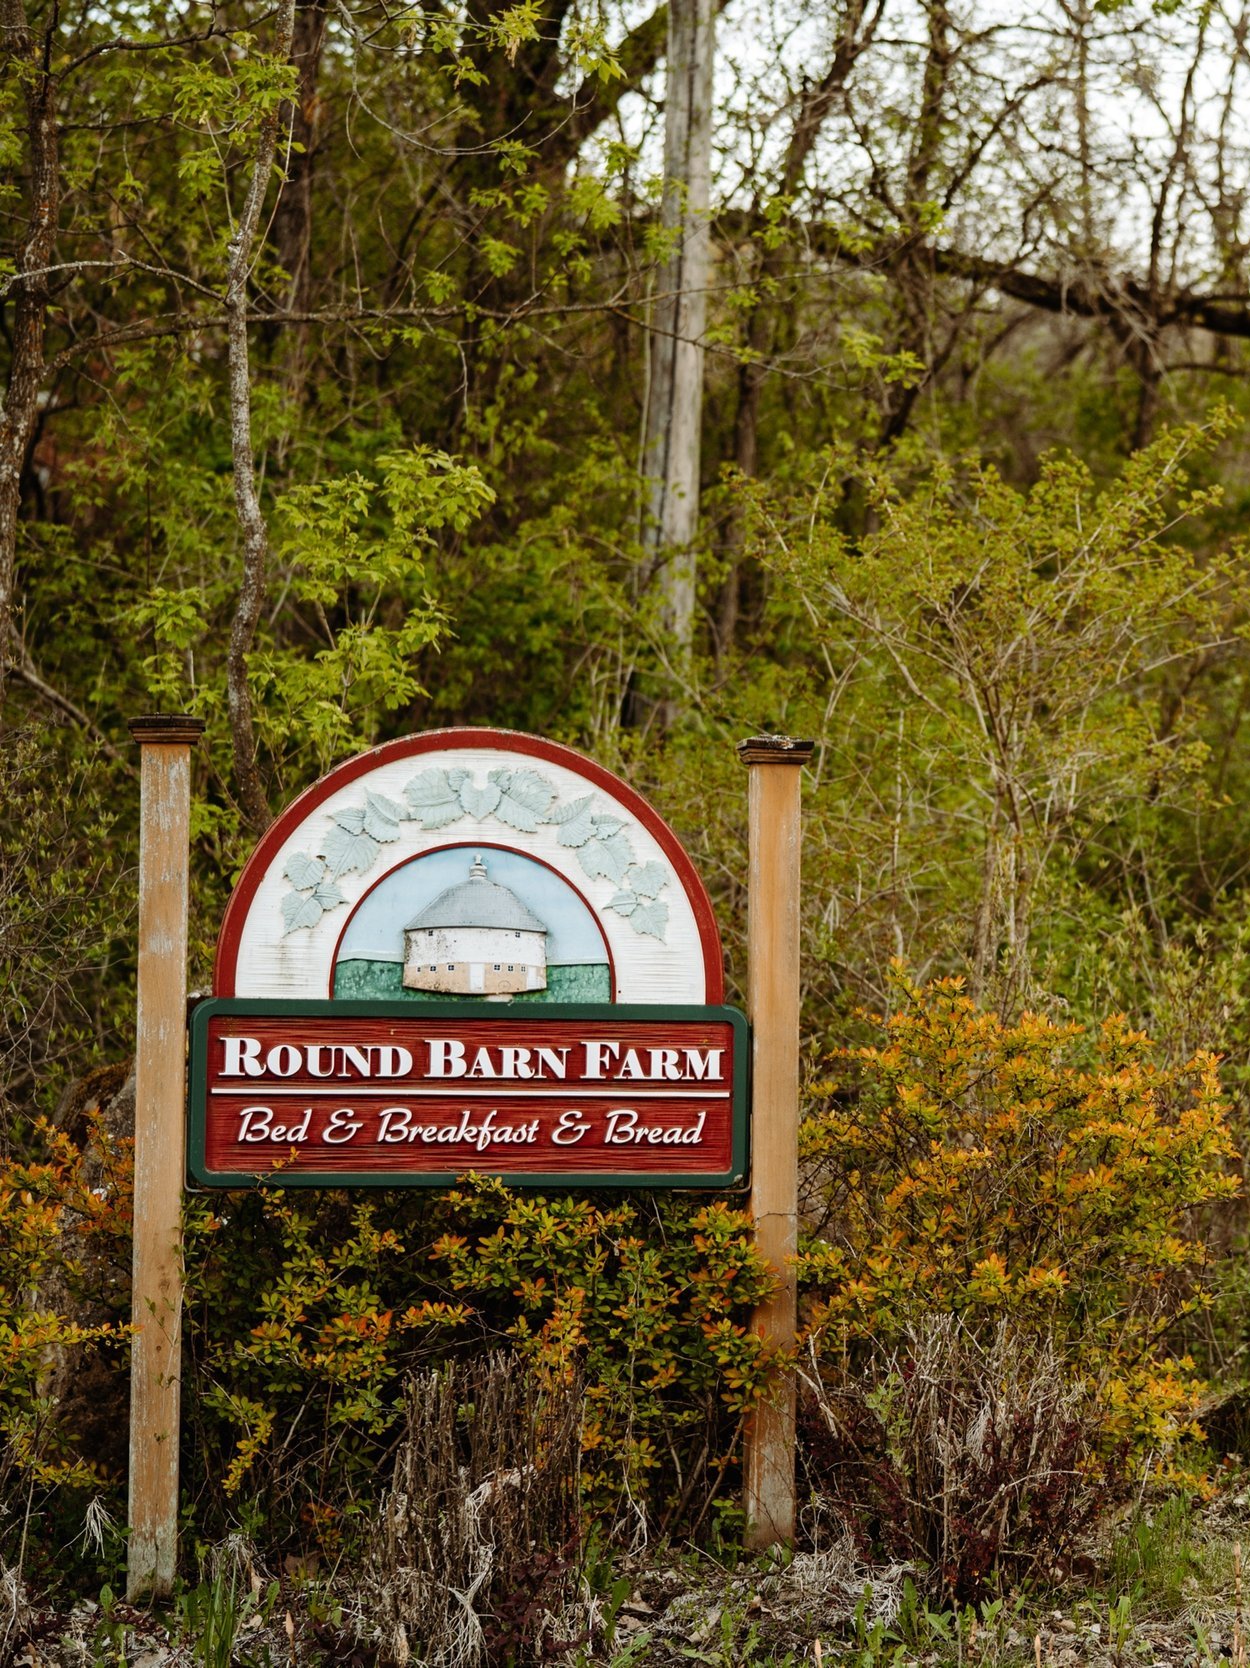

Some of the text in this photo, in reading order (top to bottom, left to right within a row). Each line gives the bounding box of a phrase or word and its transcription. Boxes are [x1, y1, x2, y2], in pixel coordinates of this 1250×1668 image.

[218, 1036, 726, 1080] ROUND BARN FARM
[236, 1106, 707, 1151] Bed & Breakfast & Bread
